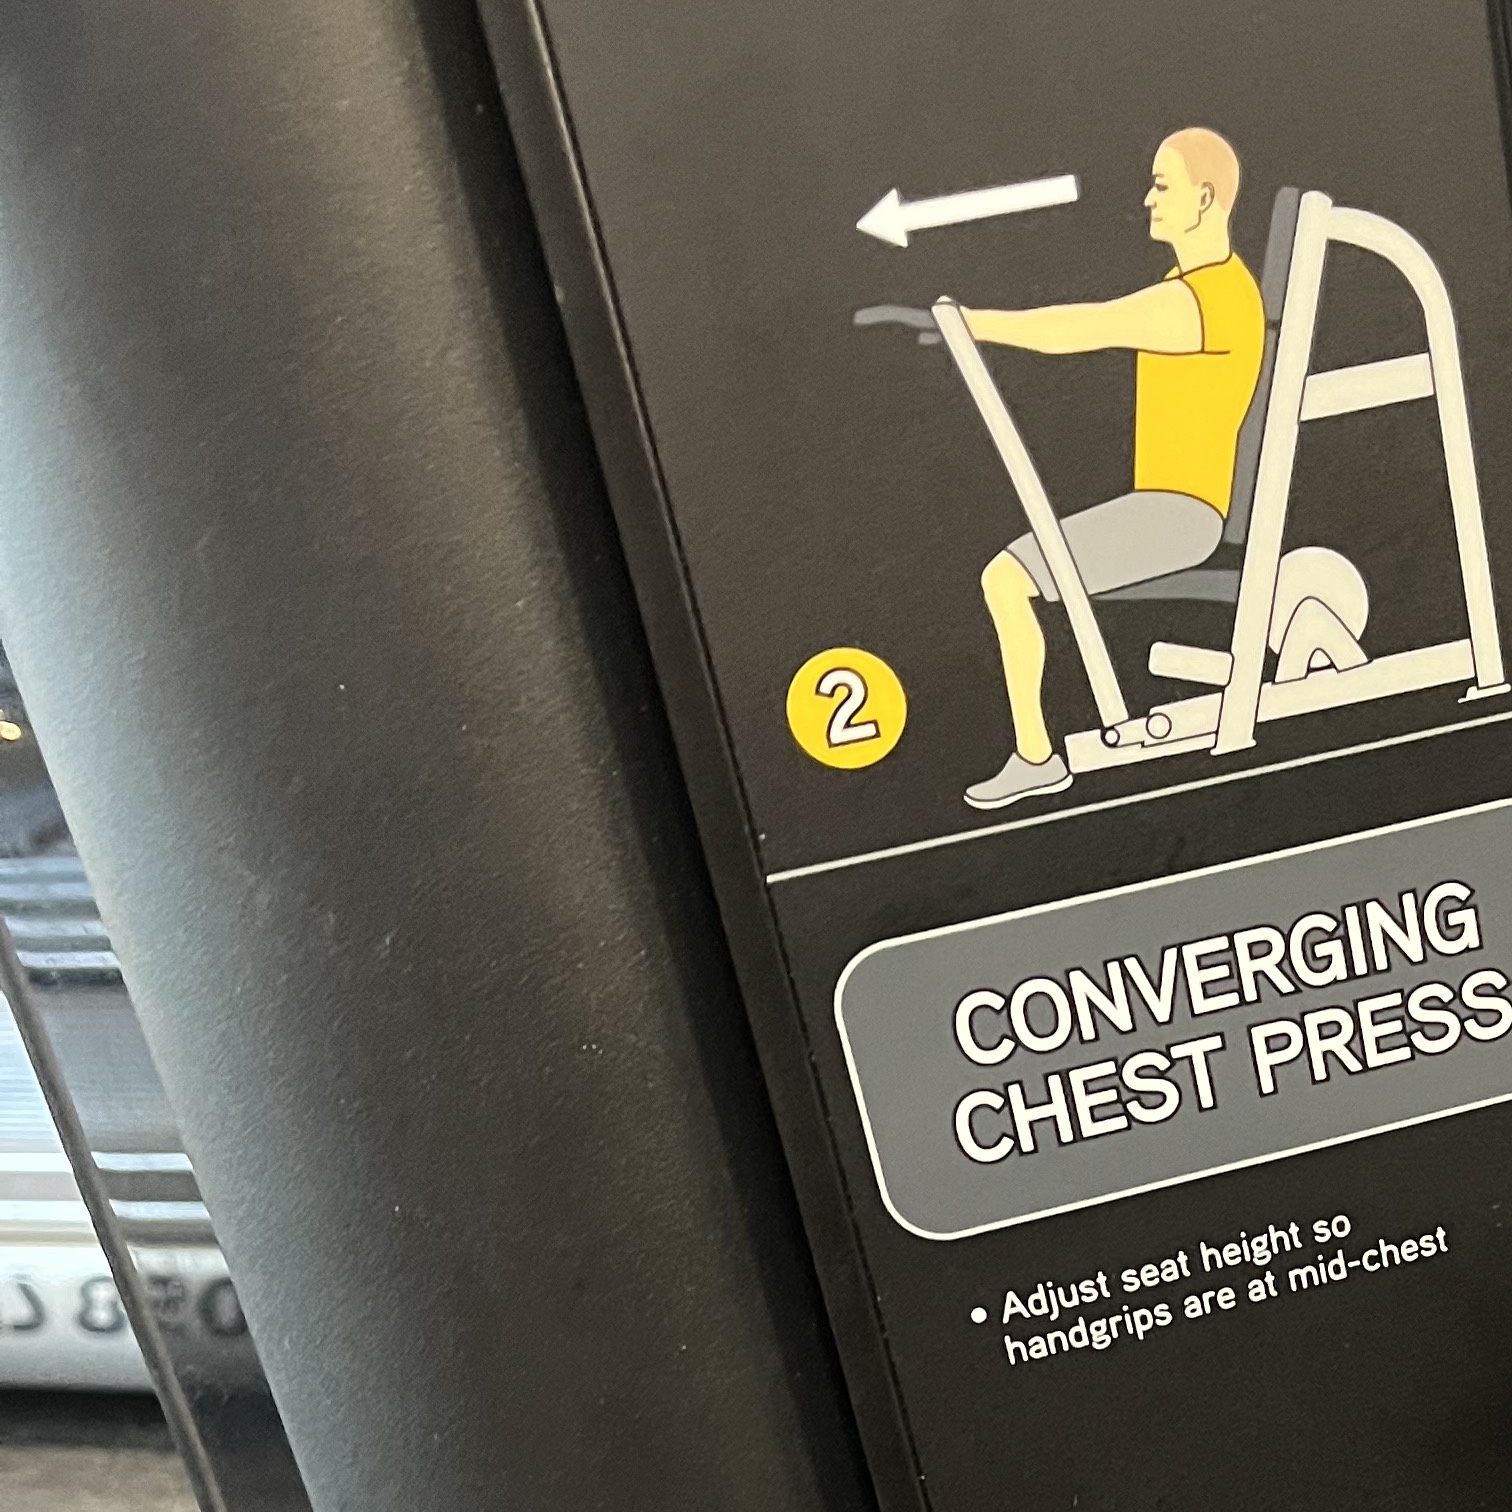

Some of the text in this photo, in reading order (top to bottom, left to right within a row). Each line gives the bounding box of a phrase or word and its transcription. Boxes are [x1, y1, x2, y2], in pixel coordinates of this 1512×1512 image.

[815, 667, 881, 748] 2
[954, 880, 1481, 1066] CONVERGING
[954, 1034, 1224, 1164] CHEST
[1002, 1214, 1351, 1323] Adjust seat height so
[1004, 1226, 1448, 1365] handgrips are at mid-chest
